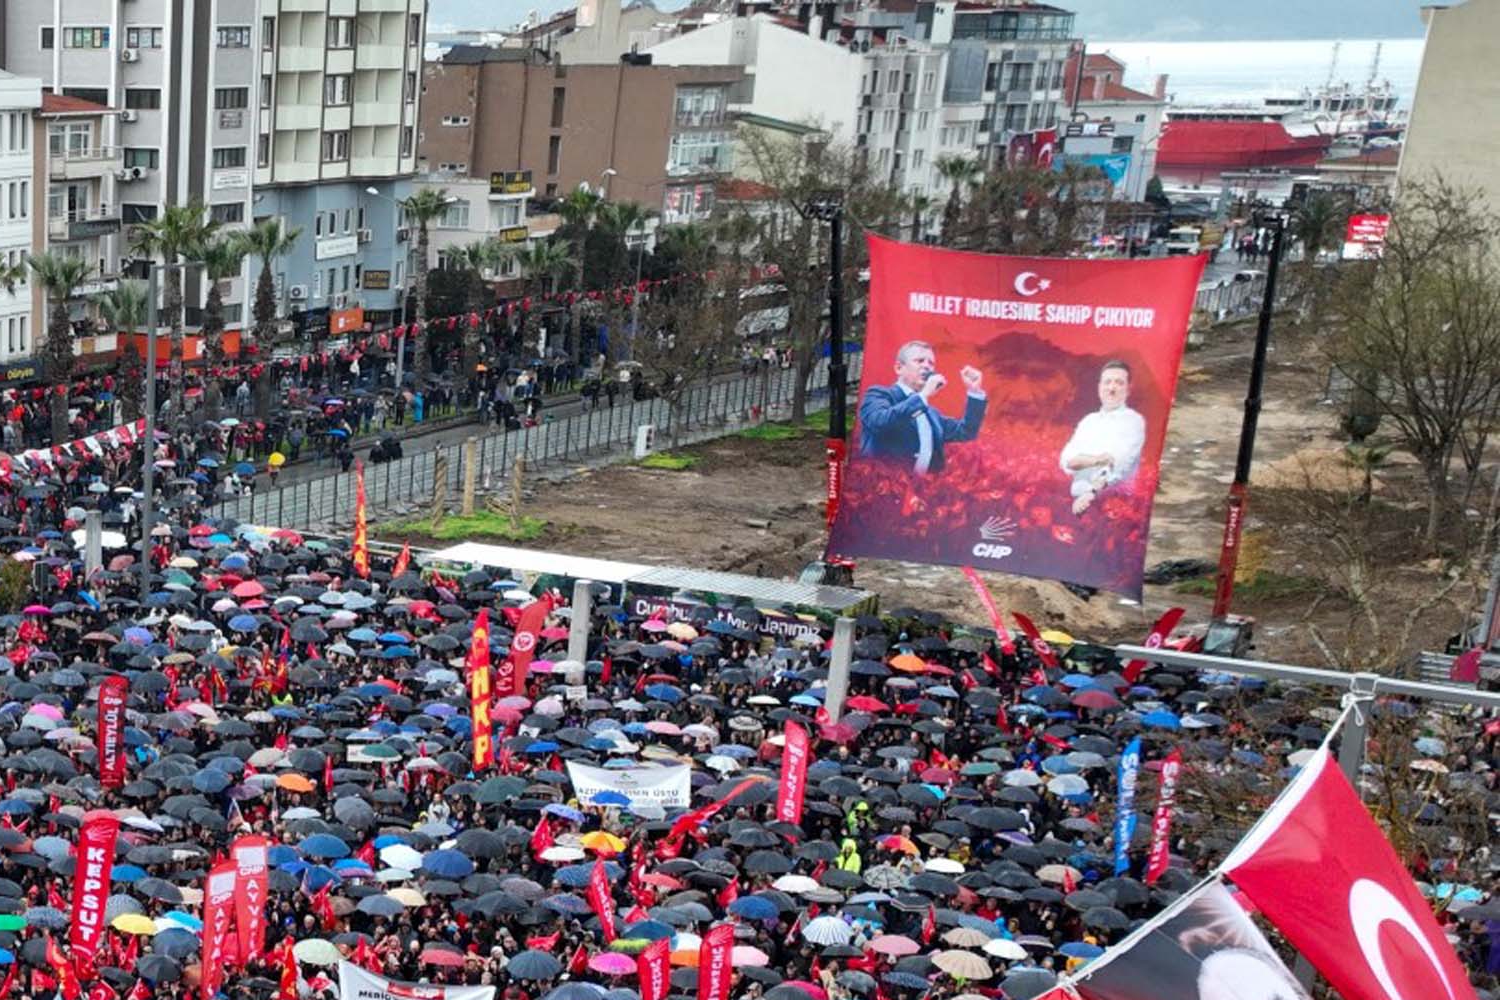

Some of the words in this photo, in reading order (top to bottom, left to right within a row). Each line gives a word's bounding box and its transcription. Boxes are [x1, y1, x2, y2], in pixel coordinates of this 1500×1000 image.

[1094, 306, 1155, 329] ÇIKIYOR
[972, 543, 1012, 559] CHP
[472, 666, 490, 764] HKP
[79, 847, 105, 942] KEPSUT
